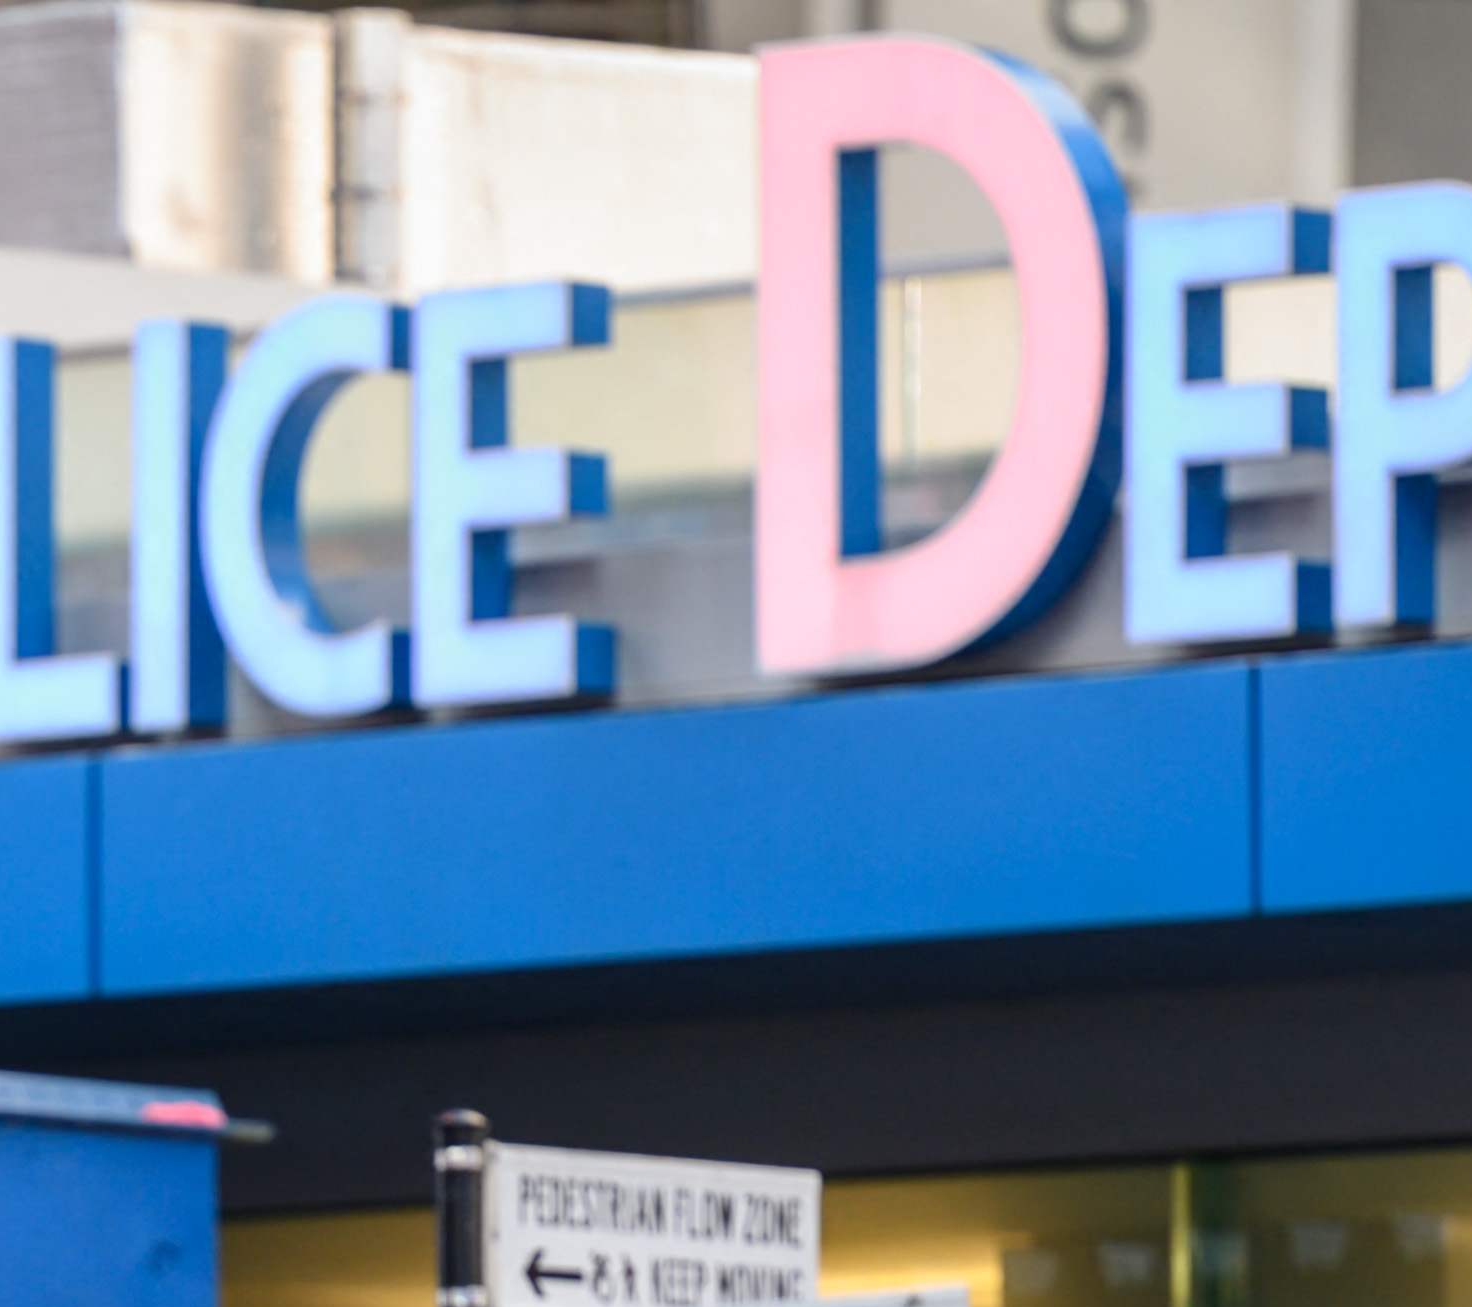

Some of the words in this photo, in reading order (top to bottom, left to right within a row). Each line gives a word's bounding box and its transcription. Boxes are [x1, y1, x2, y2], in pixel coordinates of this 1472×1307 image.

[518, 1174, 665, 1233] PEDESTRIAN
[673, 1186, 733, 1244] FLOW
[742, 1194, 802, 1248] ZONE
[652, 1257, 705, 1306] KEEP
